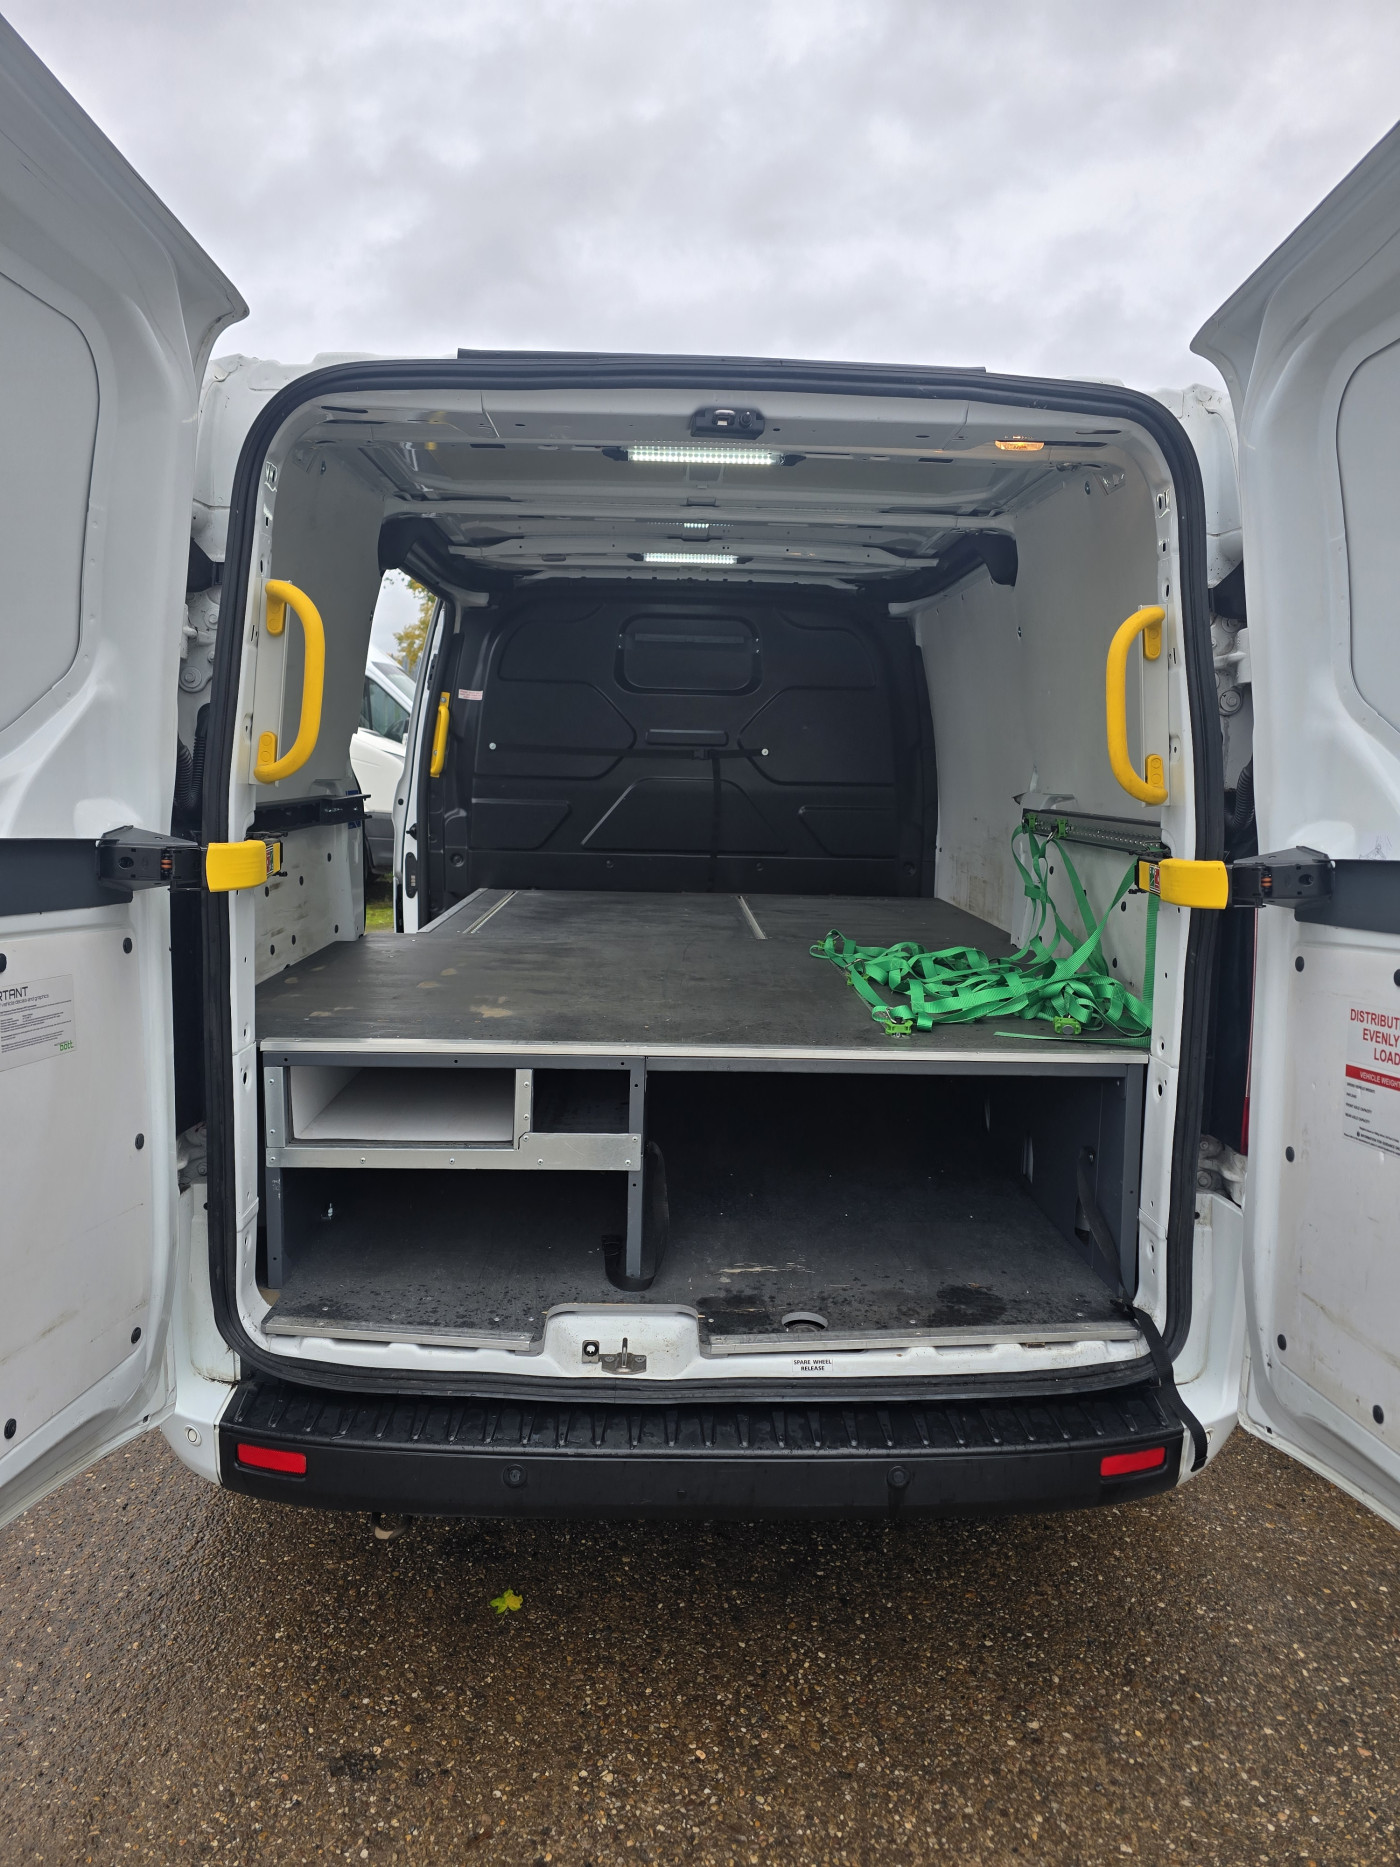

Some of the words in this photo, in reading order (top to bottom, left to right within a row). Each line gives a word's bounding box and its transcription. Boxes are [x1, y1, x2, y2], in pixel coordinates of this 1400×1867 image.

[1350, 1008, 1400, 1030] DISTRIBUT
[1363, 1028, 1400, 1048] EVENLY
[1374, 1047, 1400, 1066] LOAD
[1360, 1071, 1381, 1084] VEHICLE
